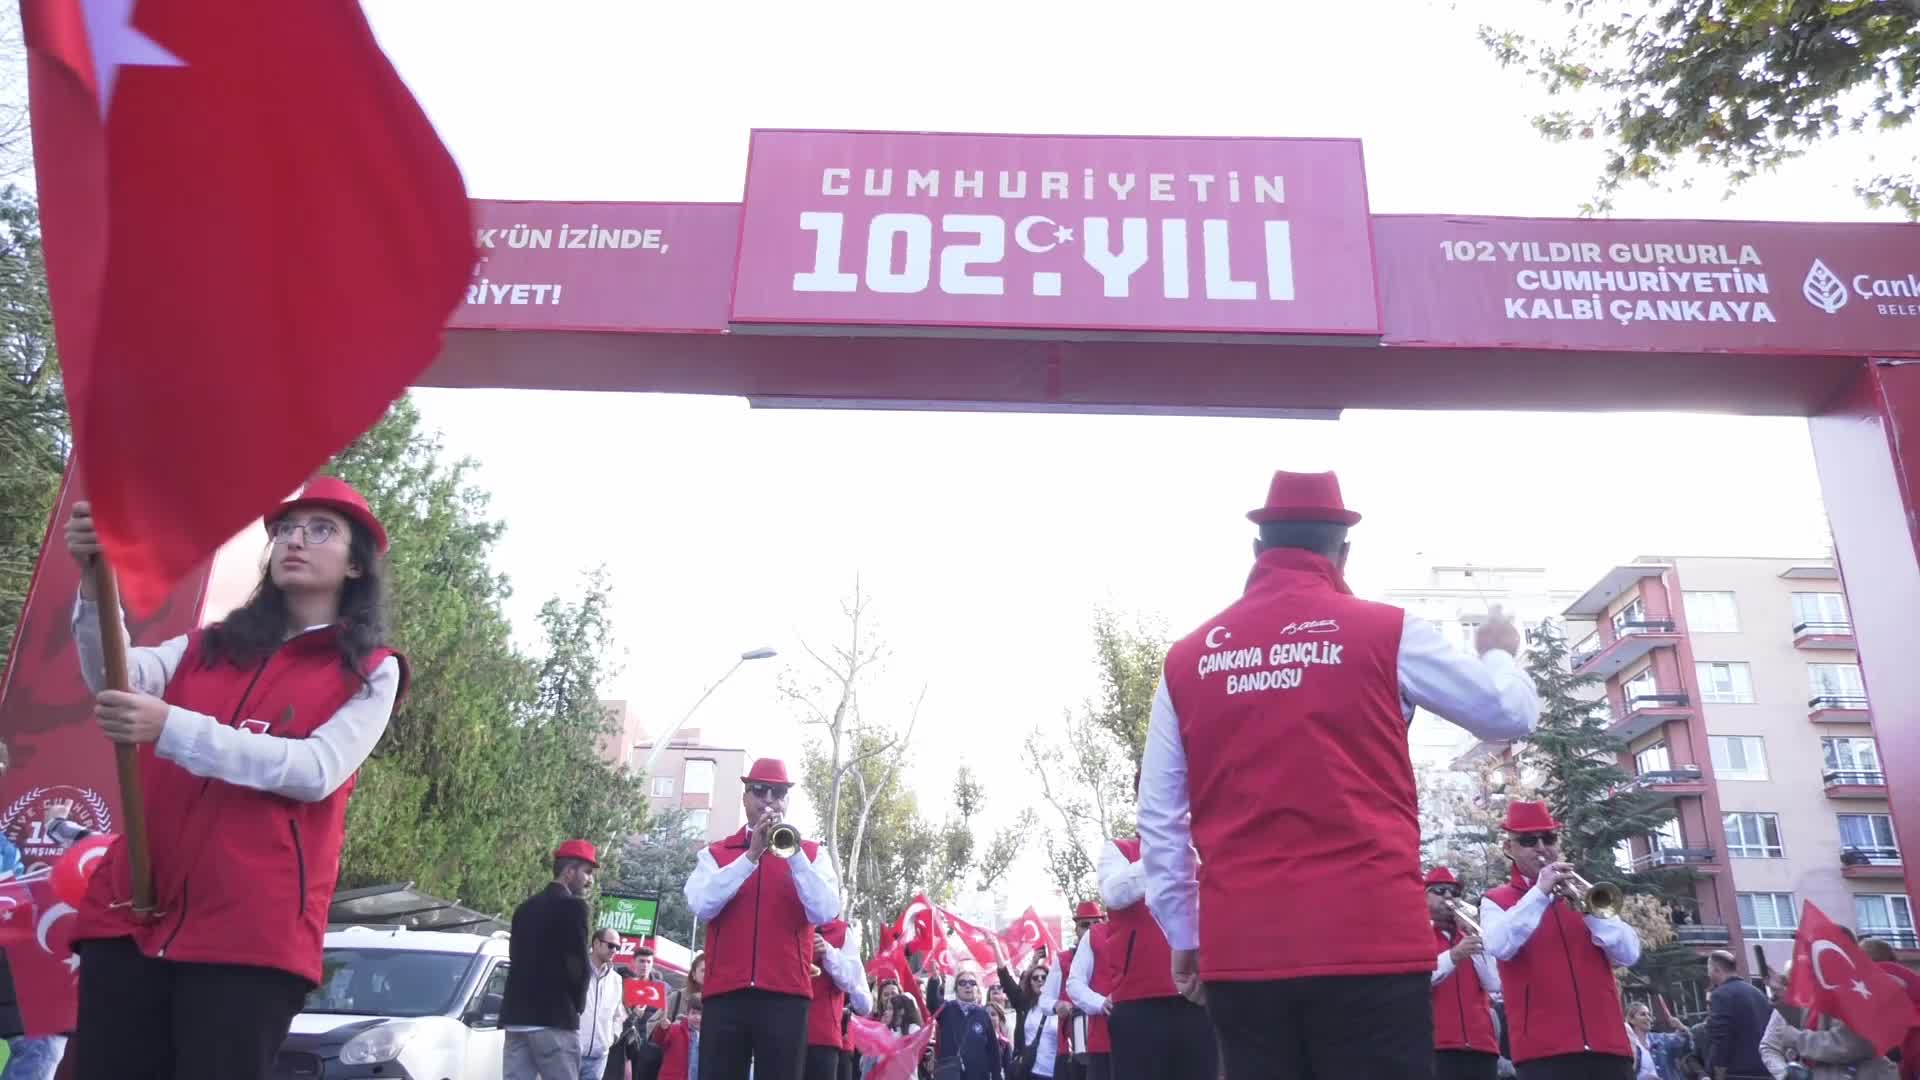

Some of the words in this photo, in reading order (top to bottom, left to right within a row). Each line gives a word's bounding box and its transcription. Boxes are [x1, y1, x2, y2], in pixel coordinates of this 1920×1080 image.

[558, 223, 669, 254] İZİNDE,
[1083, 217, 1295, 301] YILI
[1608, 243, 1761, 265] GURURLA
[1516, 266, 1769, 294] CUMHURİYETİN
[1504, 293, 1604, 320] KALBİ
[1609, 299, 1776, 326] ÇANKAYA
[1876, 303, 1920, 315] BELE
[1198, 647, 1262, 679] ÇANKAYA
[1269, 641, 1343, 667] GENÇLİK
[1226, 668, 1302, 695] BANDOSU
[598, 911, 635, 929] HATAY
